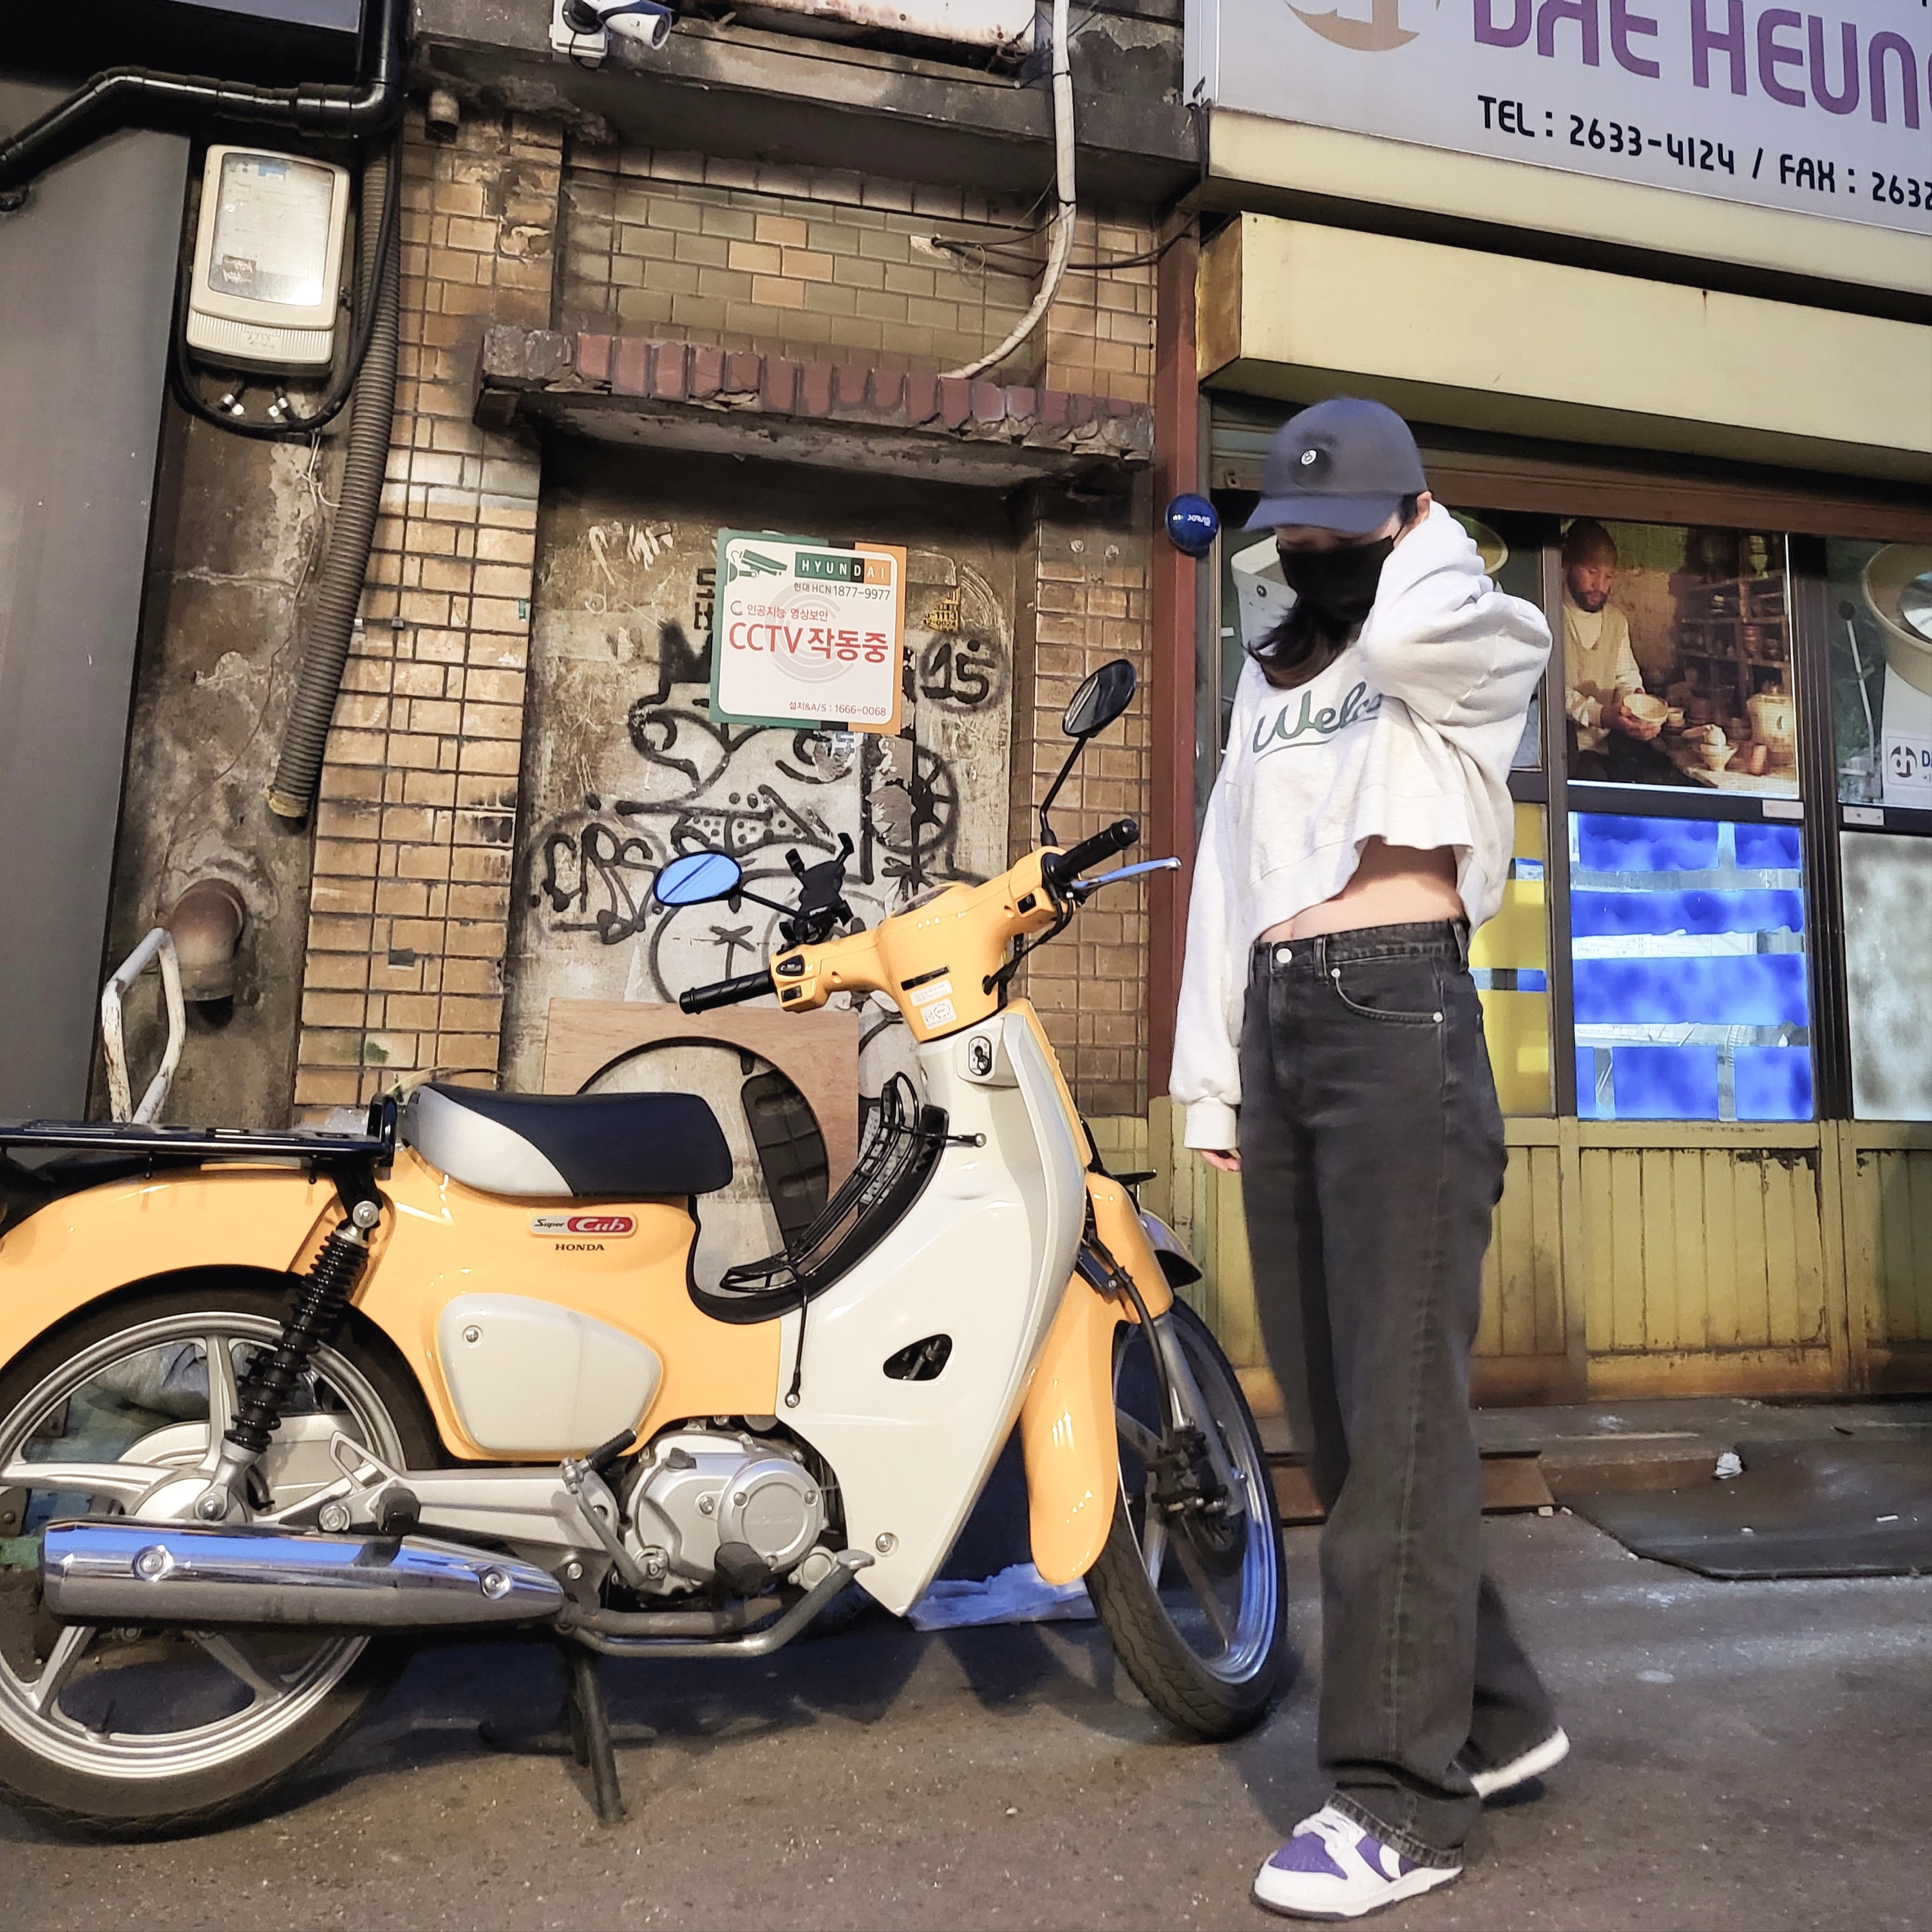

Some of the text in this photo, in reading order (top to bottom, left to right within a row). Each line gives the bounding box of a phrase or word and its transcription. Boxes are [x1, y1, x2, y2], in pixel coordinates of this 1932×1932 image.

[1690, 0, 1932, 130] HEUN
[1477, 95, 1535, 137] TEL
[1569, 115, 1734, 175] 2633-4124
[1779, 153, 1835, 193] FAX
[801, 558, 885, 579] HYUNDAI
[811, 583, 831, 594] HCN
[833, 585, 891, 601] 1877-9977
[747, 603, 786, 619] 인공지능
[790, 608, 829, 622] 영상보안
[729, 622, 889, 663] CCTV 작동중
[789, 701, 827, 712] 설치&A/S
[835, 704, 887, 716] 1666-0068
[1921, 750, 1932, 768] D
[534, 1218, 625, 1231] Super Cub
